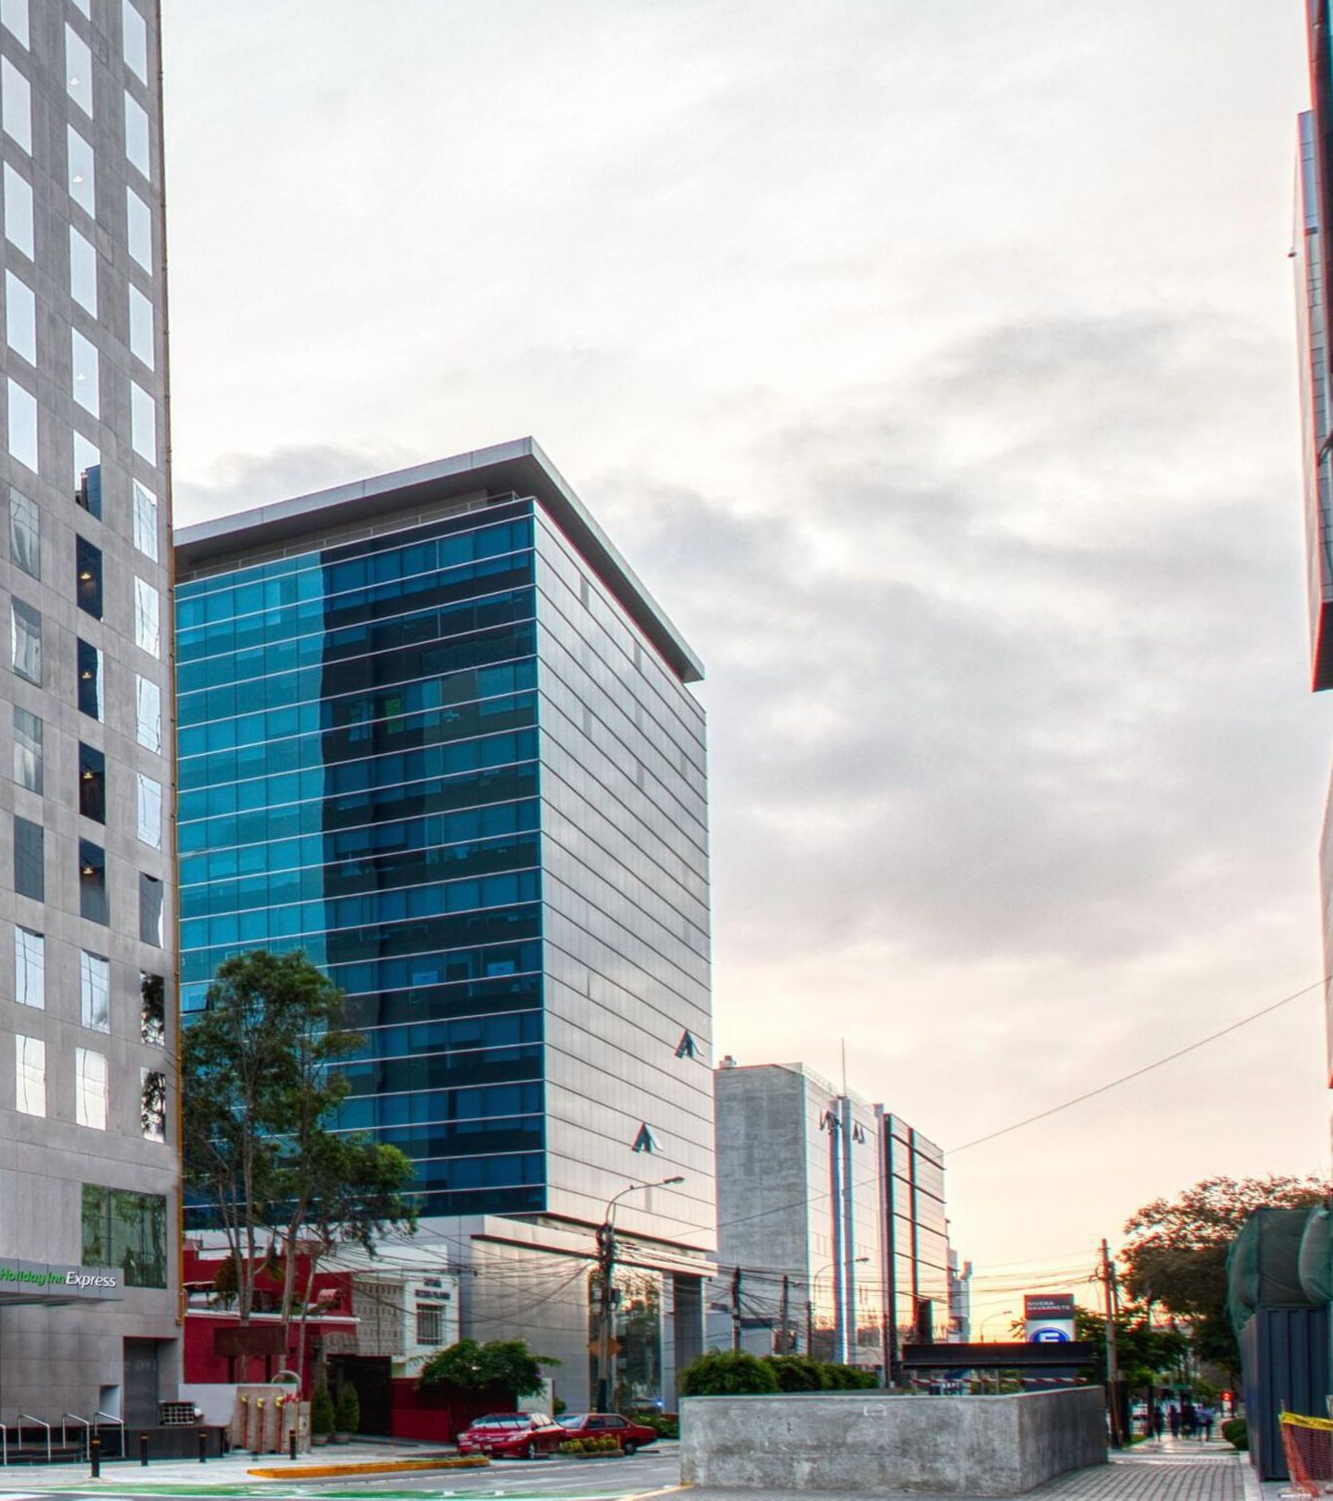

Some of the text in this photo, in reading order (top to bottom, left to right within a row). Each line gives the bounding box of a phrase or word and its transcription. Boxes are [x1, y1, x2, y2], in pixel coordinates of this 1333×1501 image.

[0, 1268, 117, 1288] Holiday Inn Express
